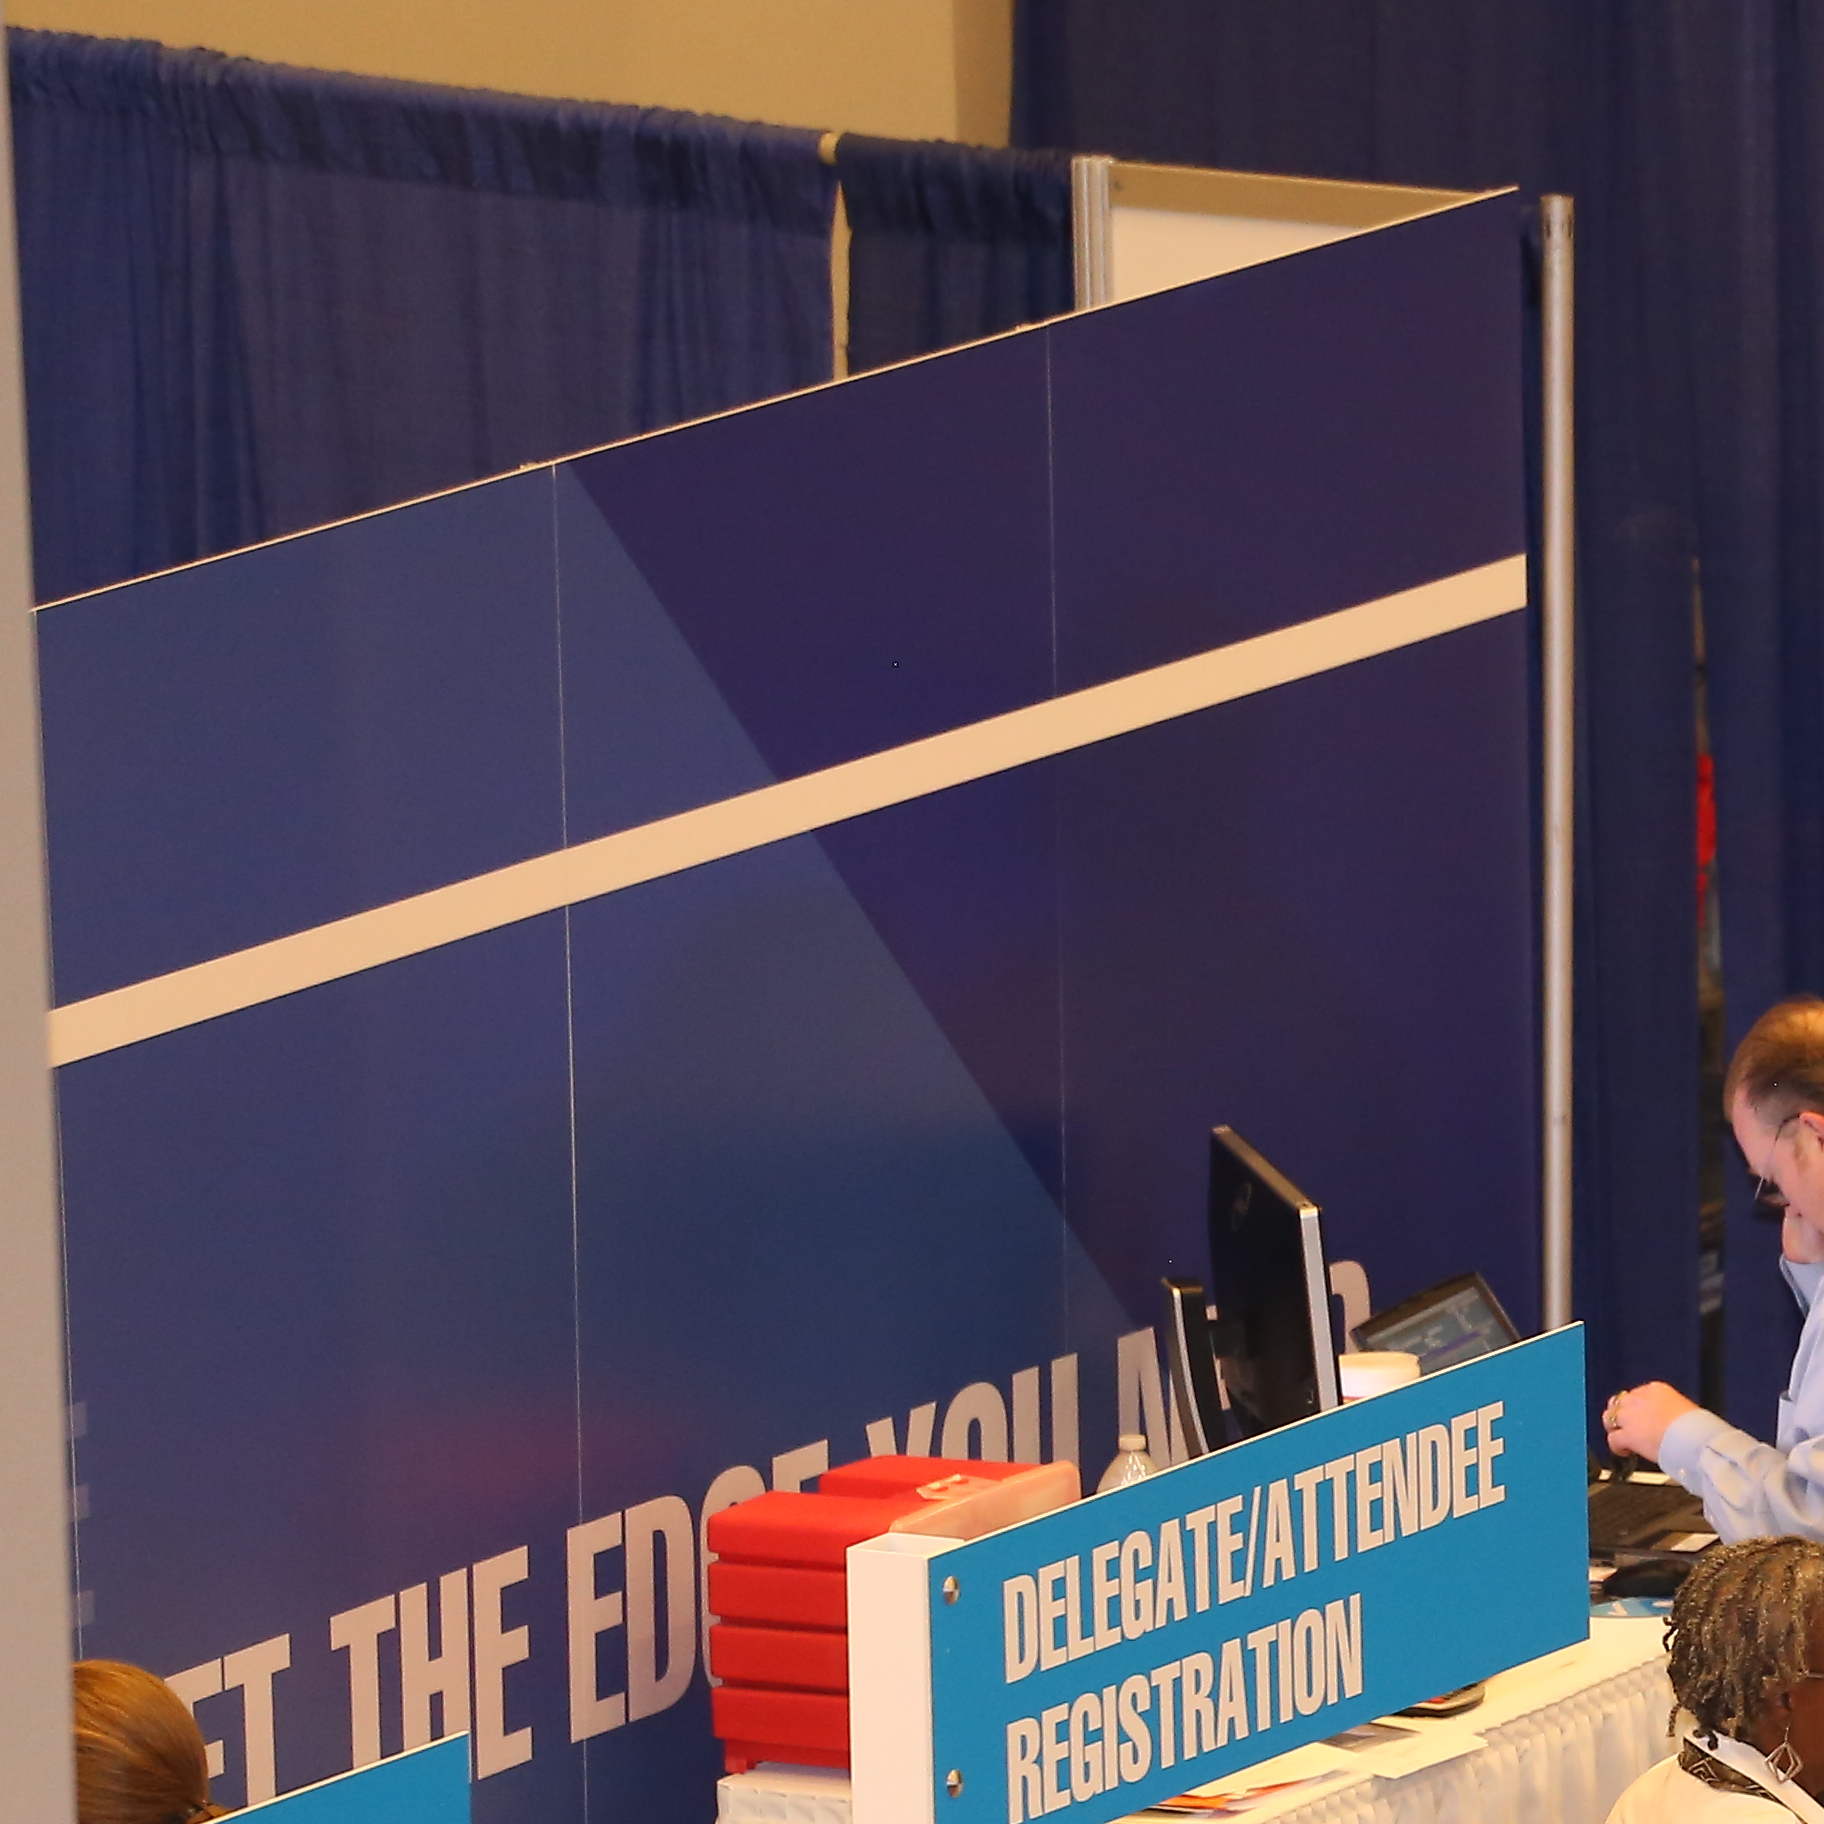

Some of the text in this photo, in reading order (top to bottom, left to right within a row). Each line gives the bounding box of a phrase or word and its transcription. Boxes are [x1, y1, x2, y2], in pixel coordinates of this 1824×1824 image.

[330, 1546, 532, 1779] THE
[567, 1440, 828, 1744] ED
[1004, 1401, 1506, 1685] DELEGATE/ATTENDEE
